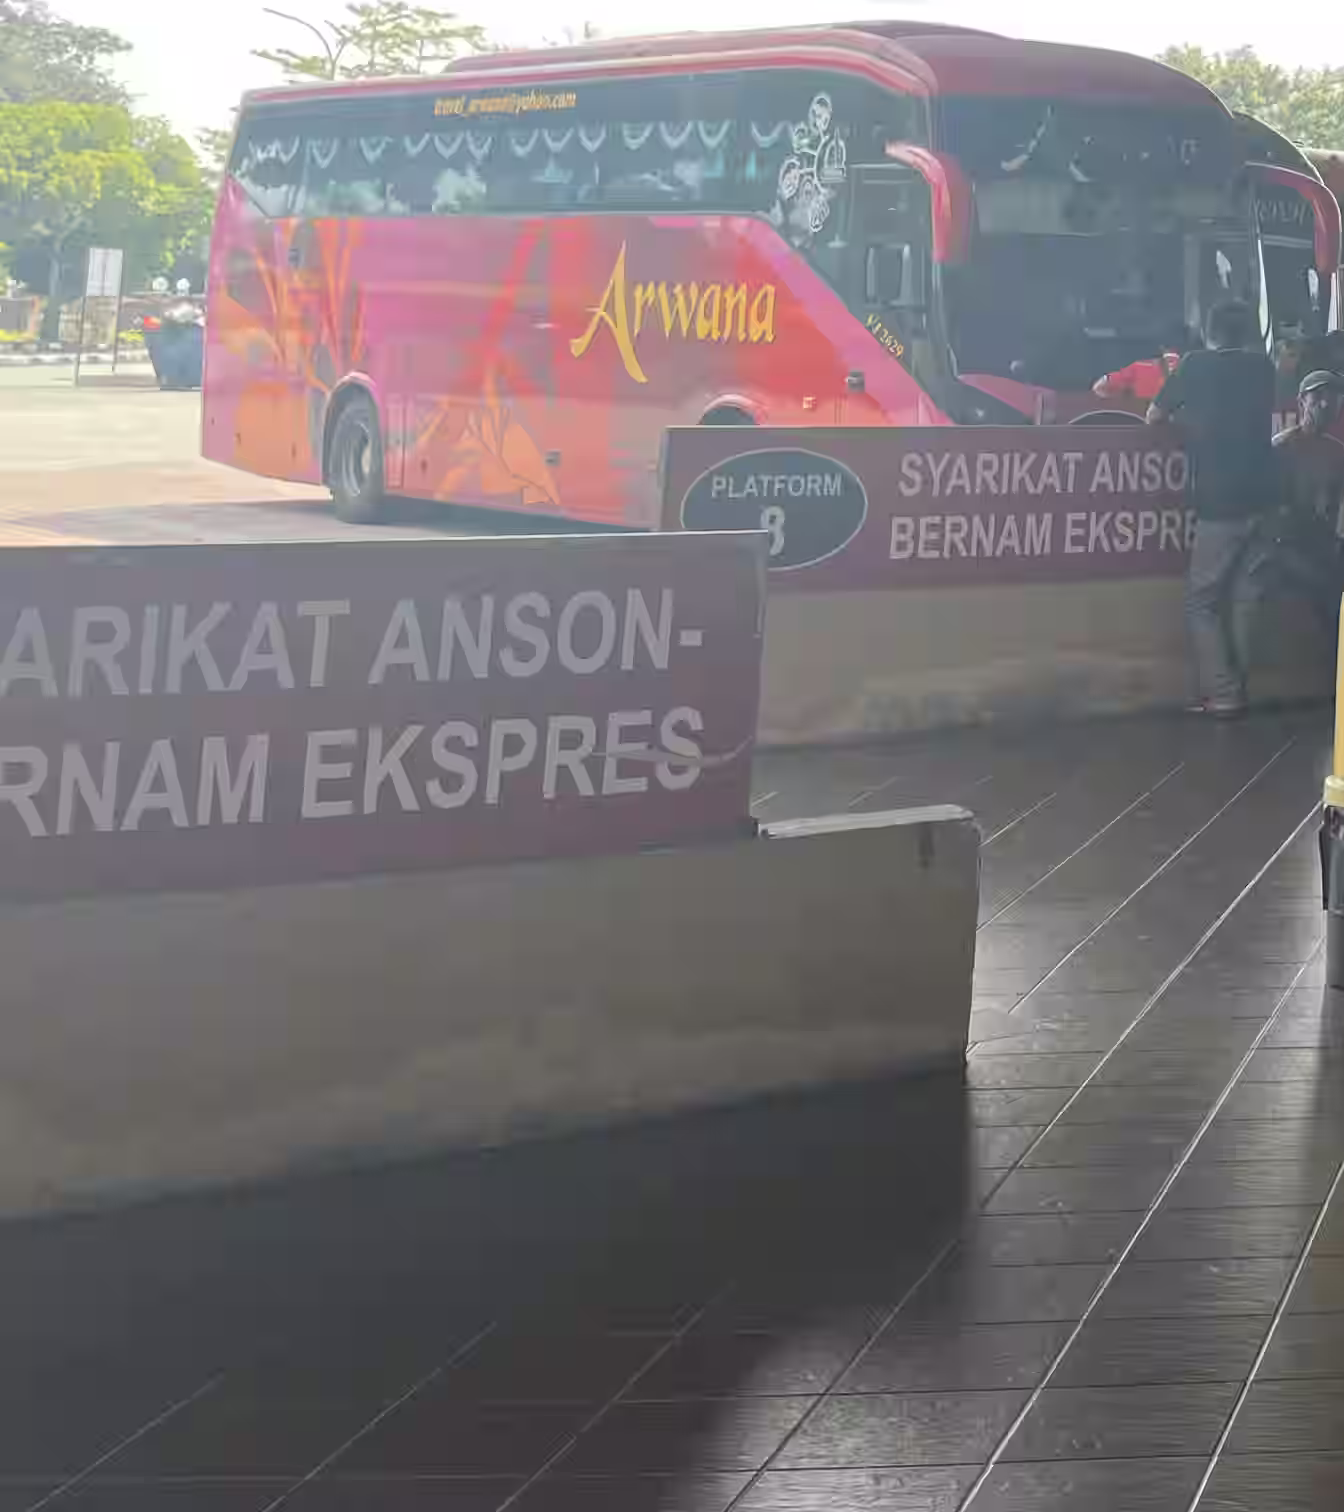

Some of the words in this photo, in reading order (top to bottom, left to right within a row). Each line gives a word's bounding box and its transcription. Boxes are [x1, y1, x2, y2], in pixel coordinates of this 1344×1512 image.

[570, 239, 776, 383] Arwana
[711, 473, 842, 499] PLATFORM
[899, 452, 1083, 497] SYARIKAT
[1091, 452, 1195, 493] ANSO
[760, 506, 786, 556] 8
[889, 513, 1052, 560] BERNAM
[1064, 508, 1197, 555] EKSPRE
[301, 705, 704, 818] EKSPRES
